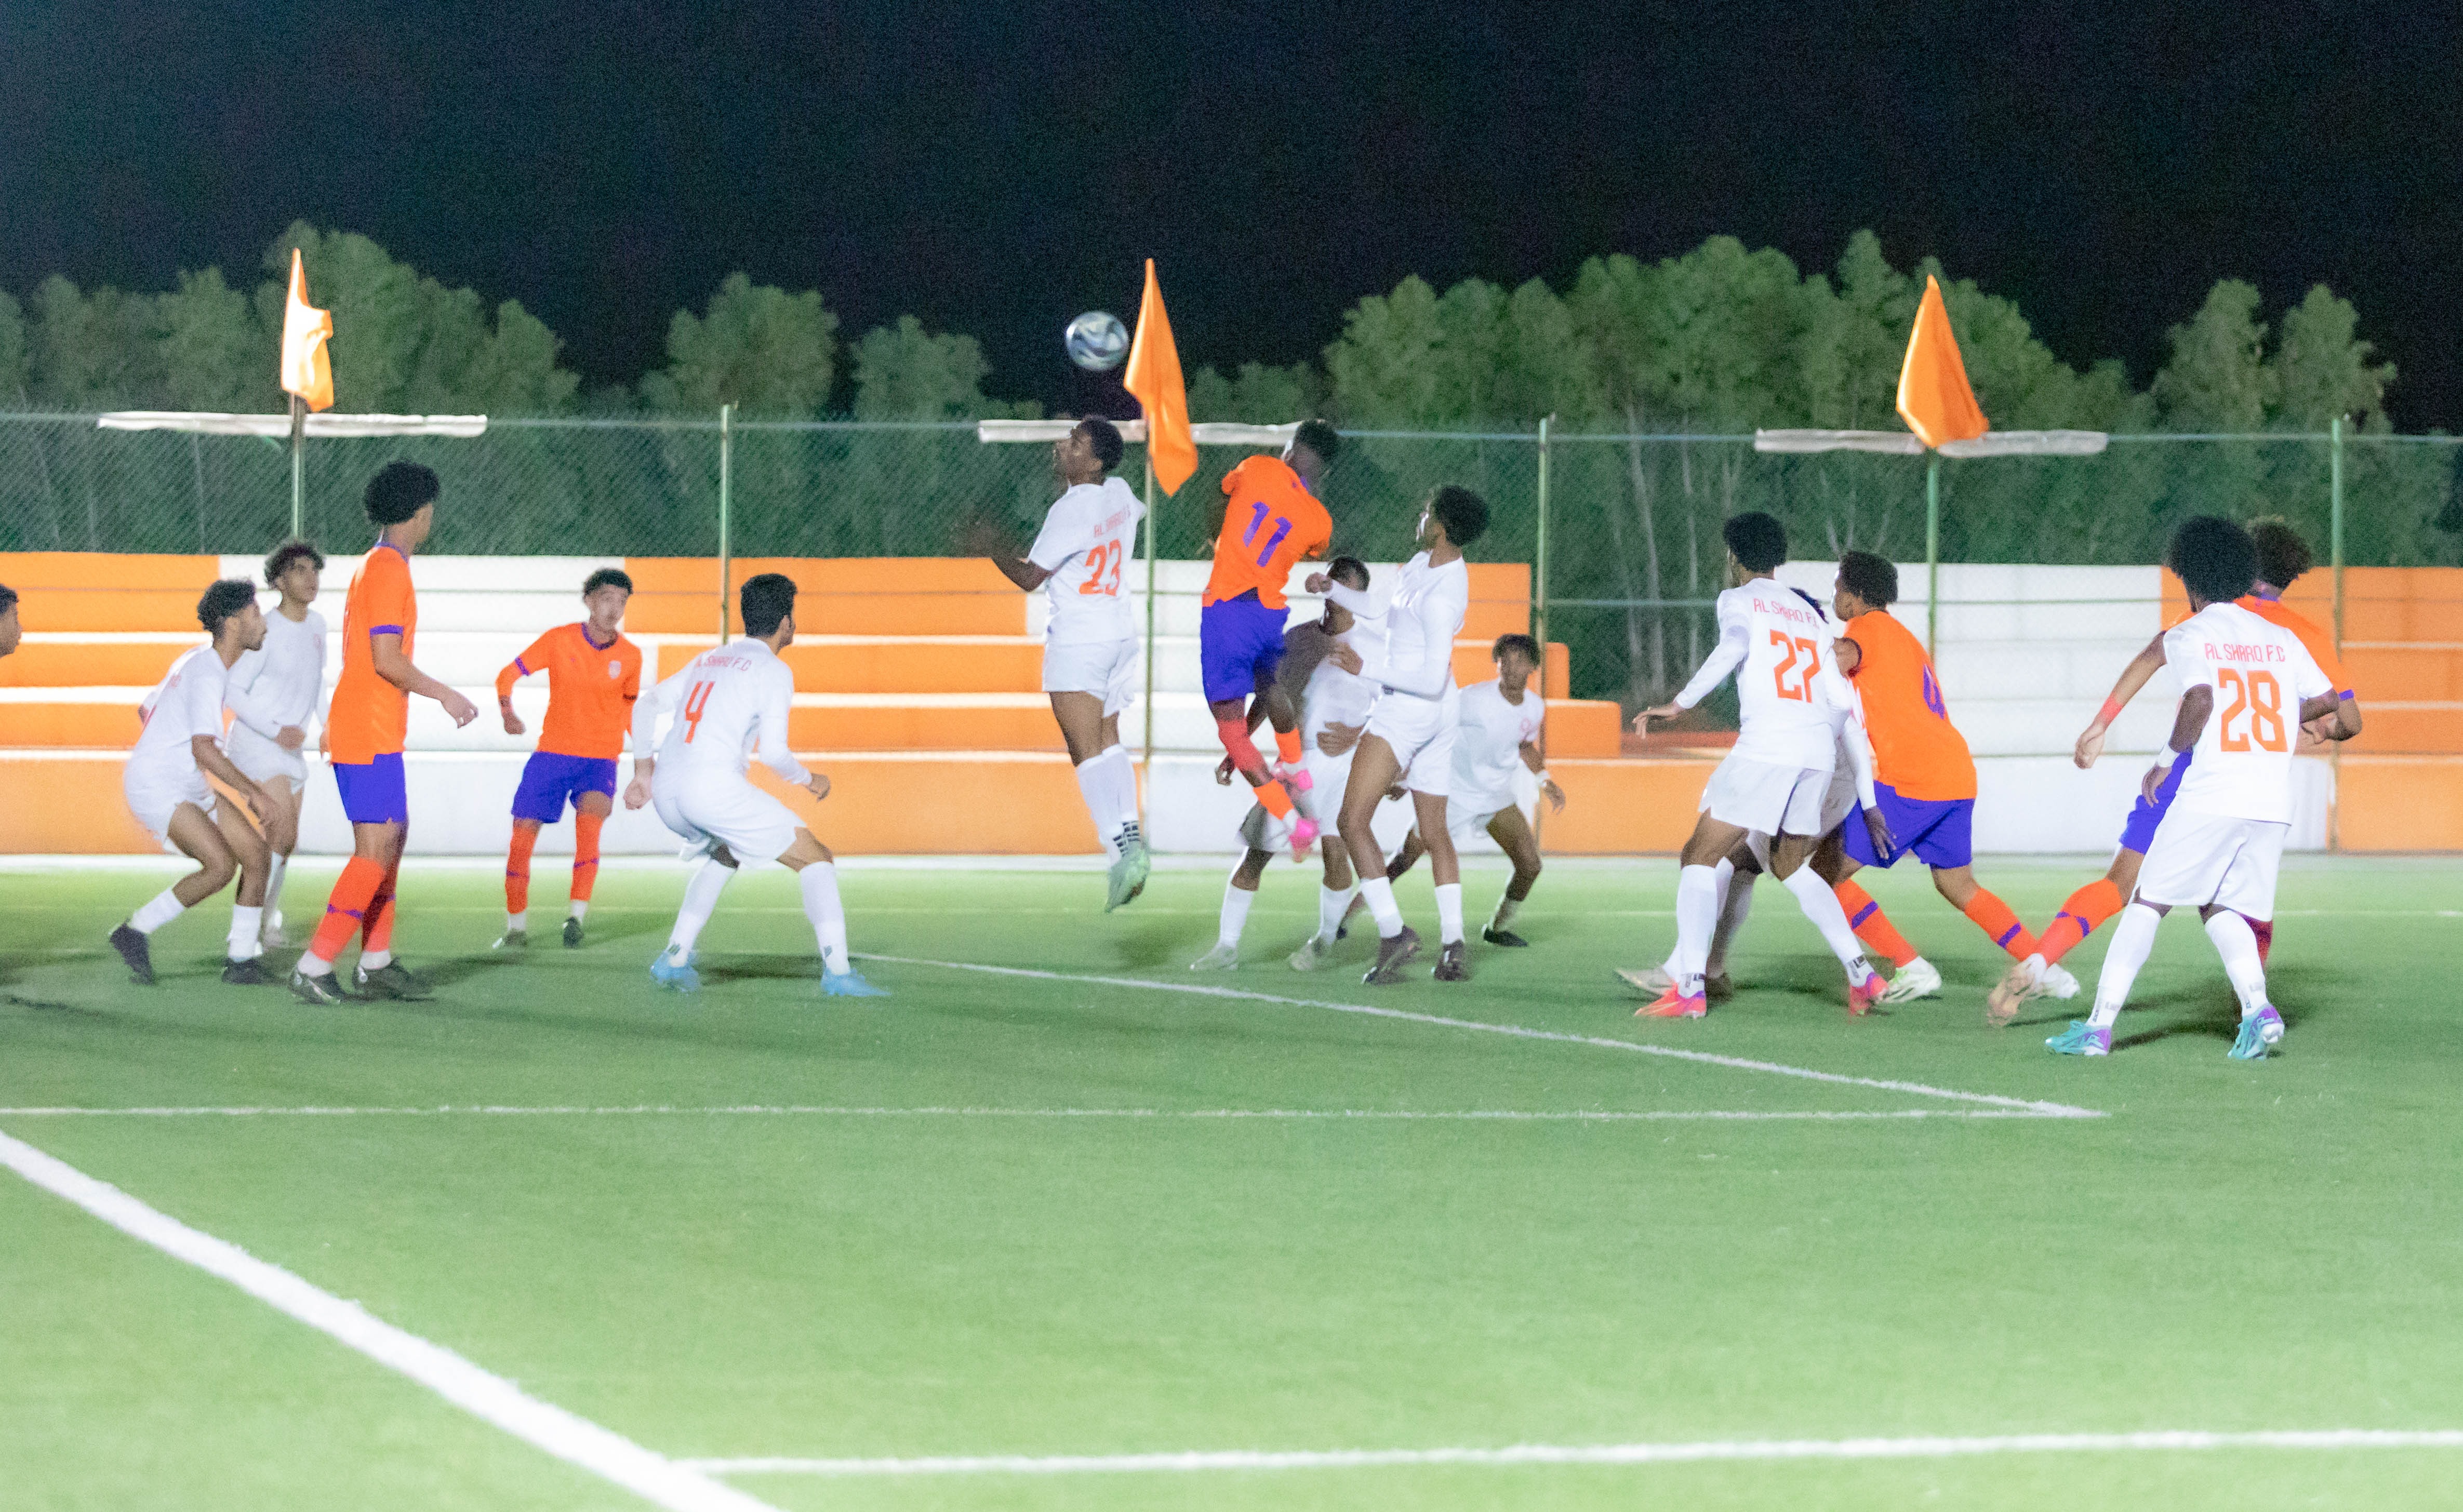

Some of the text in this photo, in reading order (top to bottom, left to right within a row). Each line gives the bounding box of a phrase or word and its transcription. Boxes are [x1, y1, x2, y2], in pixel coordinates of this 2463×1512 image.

[1242, 501, 1293, 568] 11
[1079, 538, 1122, 596] 23
[1753, 598, 1770, 613] AL
[1769, 628, 1821, 703] 27
[2204, 643, 2285, 663] AL SHARQ F.C
[684, 680, 716, 744] 4
[2218, 667, 2288, 752] 28
